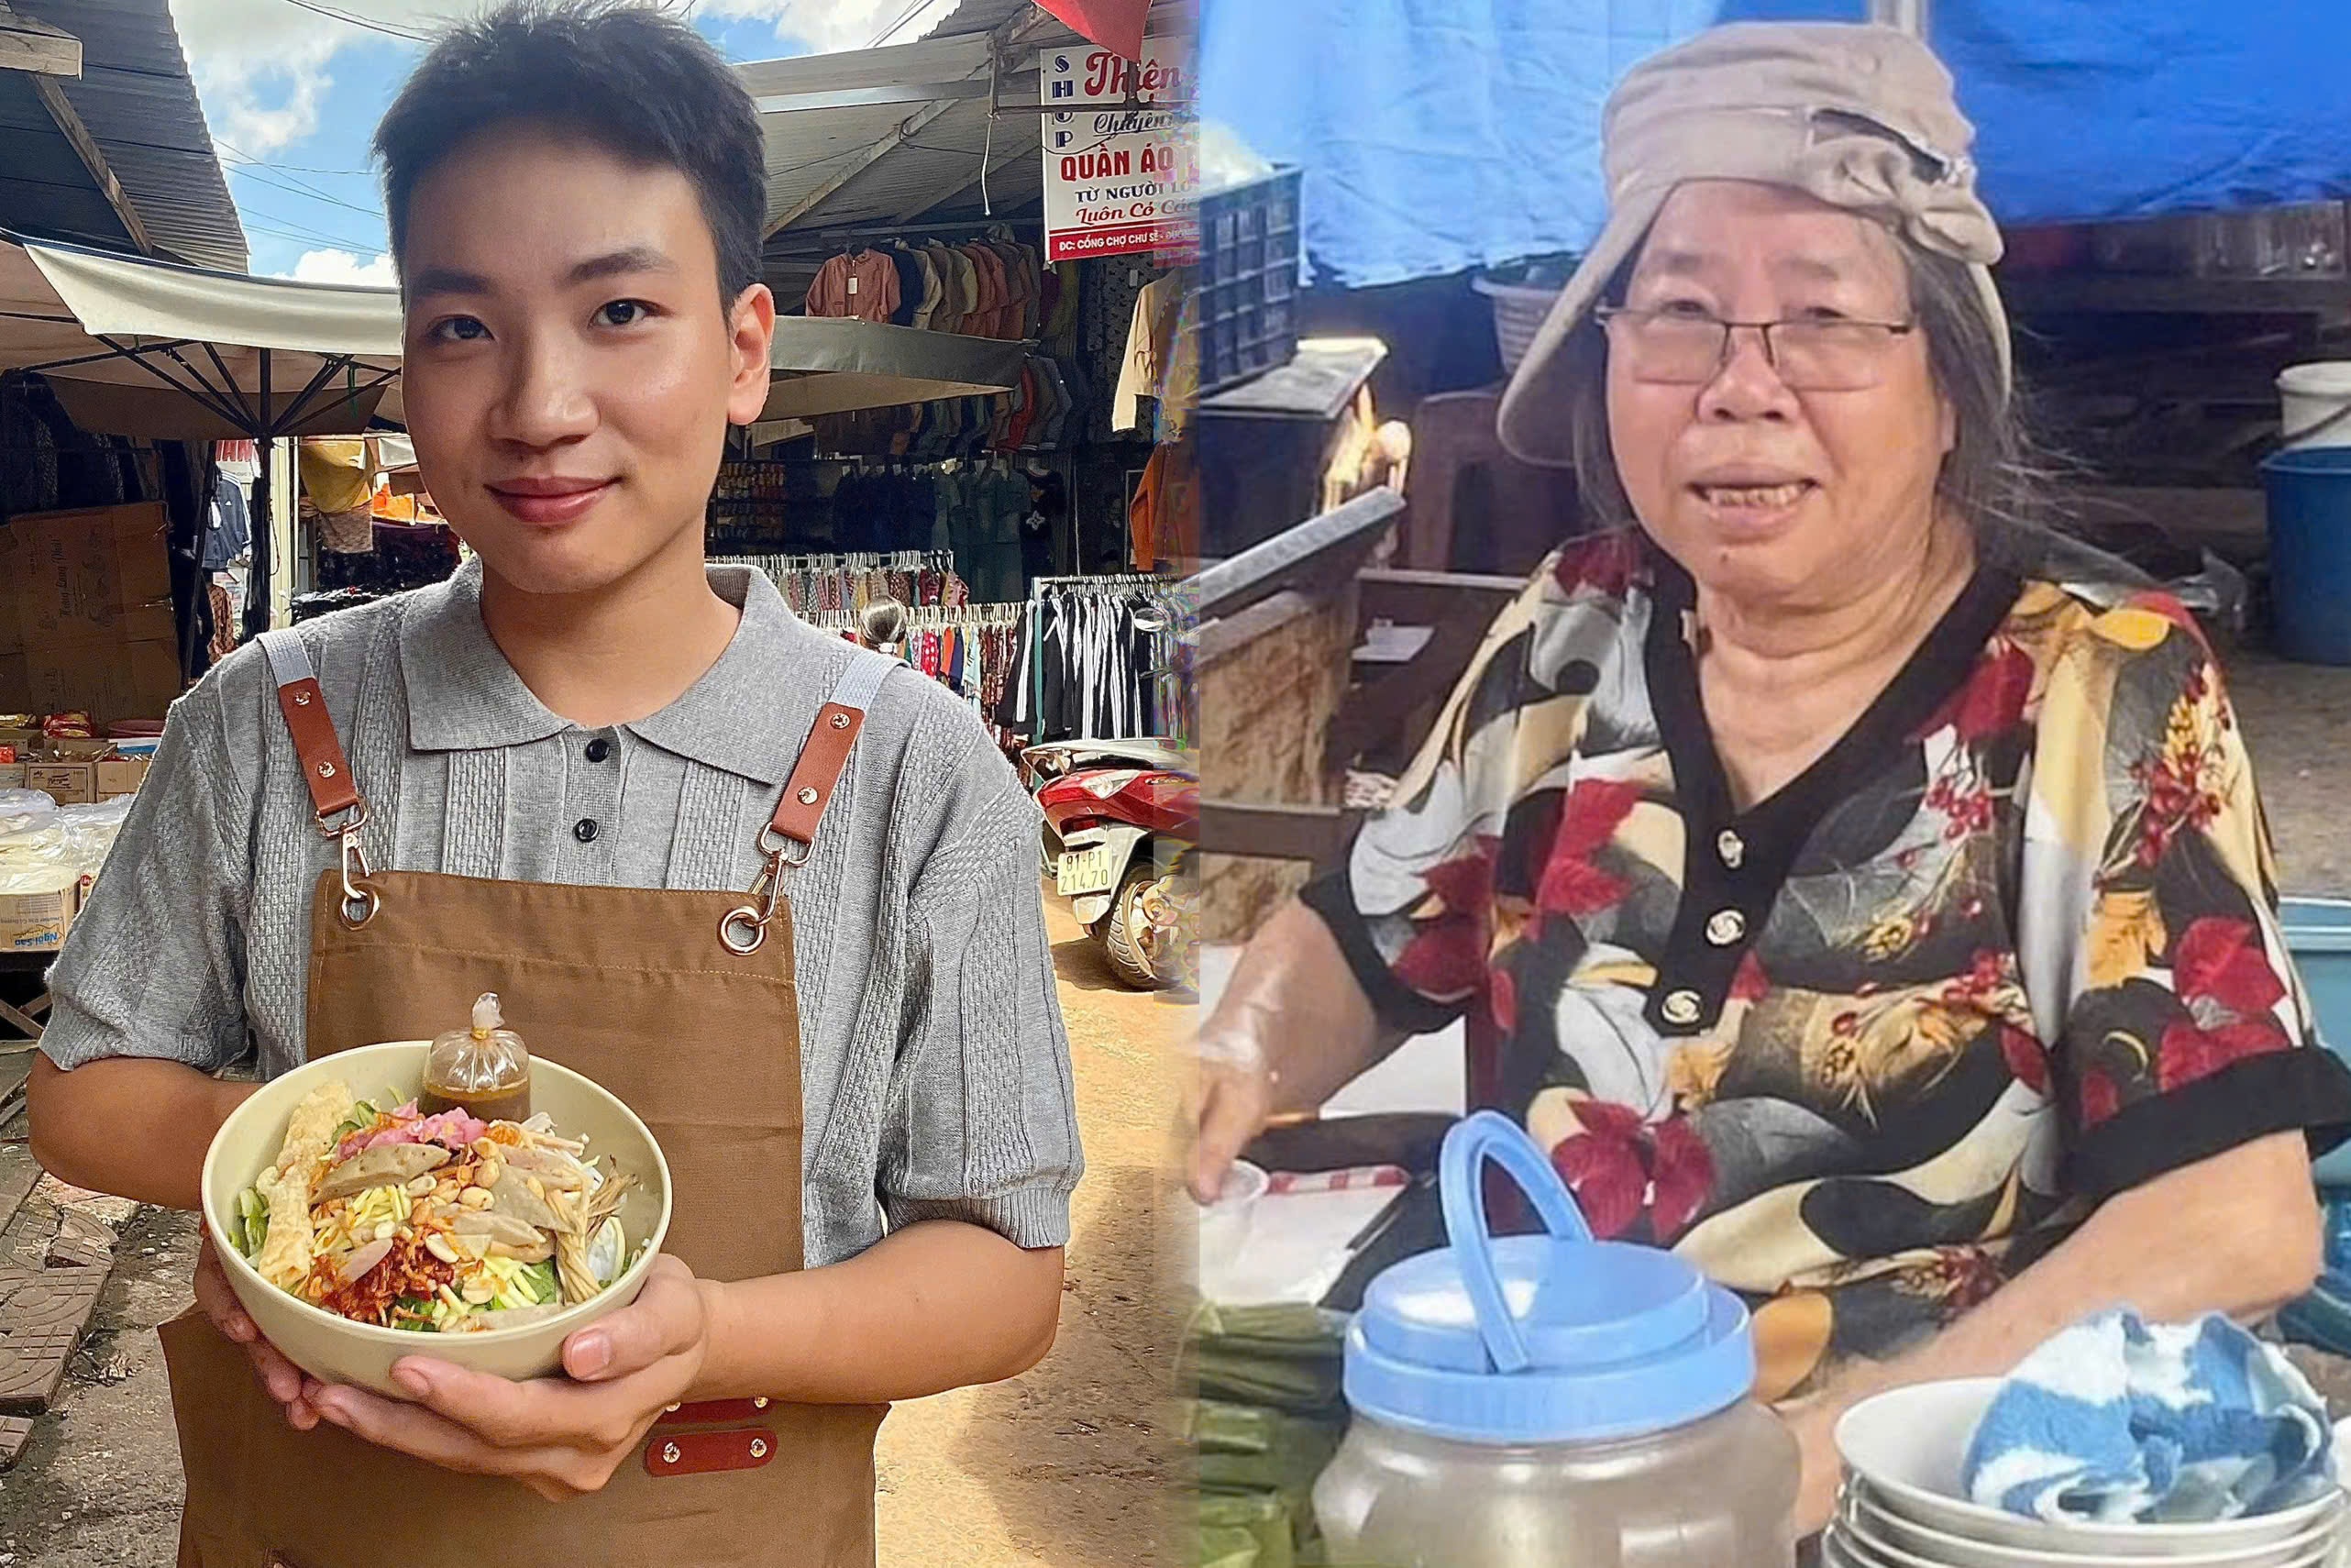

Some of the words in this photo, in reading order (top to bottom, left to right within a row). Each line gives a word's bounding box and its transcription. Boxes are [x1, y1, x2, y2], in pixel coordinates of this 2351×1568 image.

[1085, 51, 1181, 102] Thện
[1061, 143, 1131, 182] QUẦN
[1141, 143, 1174, 173] ÁO
[1076, 186, 1100, 204] TỪ
[1106, 181, 1164, 201] NGƯỜI
[1076, 206, 1126, 226] Luôn
[1130, 201, 1155, 218] Có
[1077, 233, 1105, 250] CỔNG
[1106, 234, 1127, 248] CHỢ
[1128, 231, 1149, 243] CHƯ
[1067, 851, 1102, 871] 81-P1
[1062, 869, 1108, 892] 214.70
